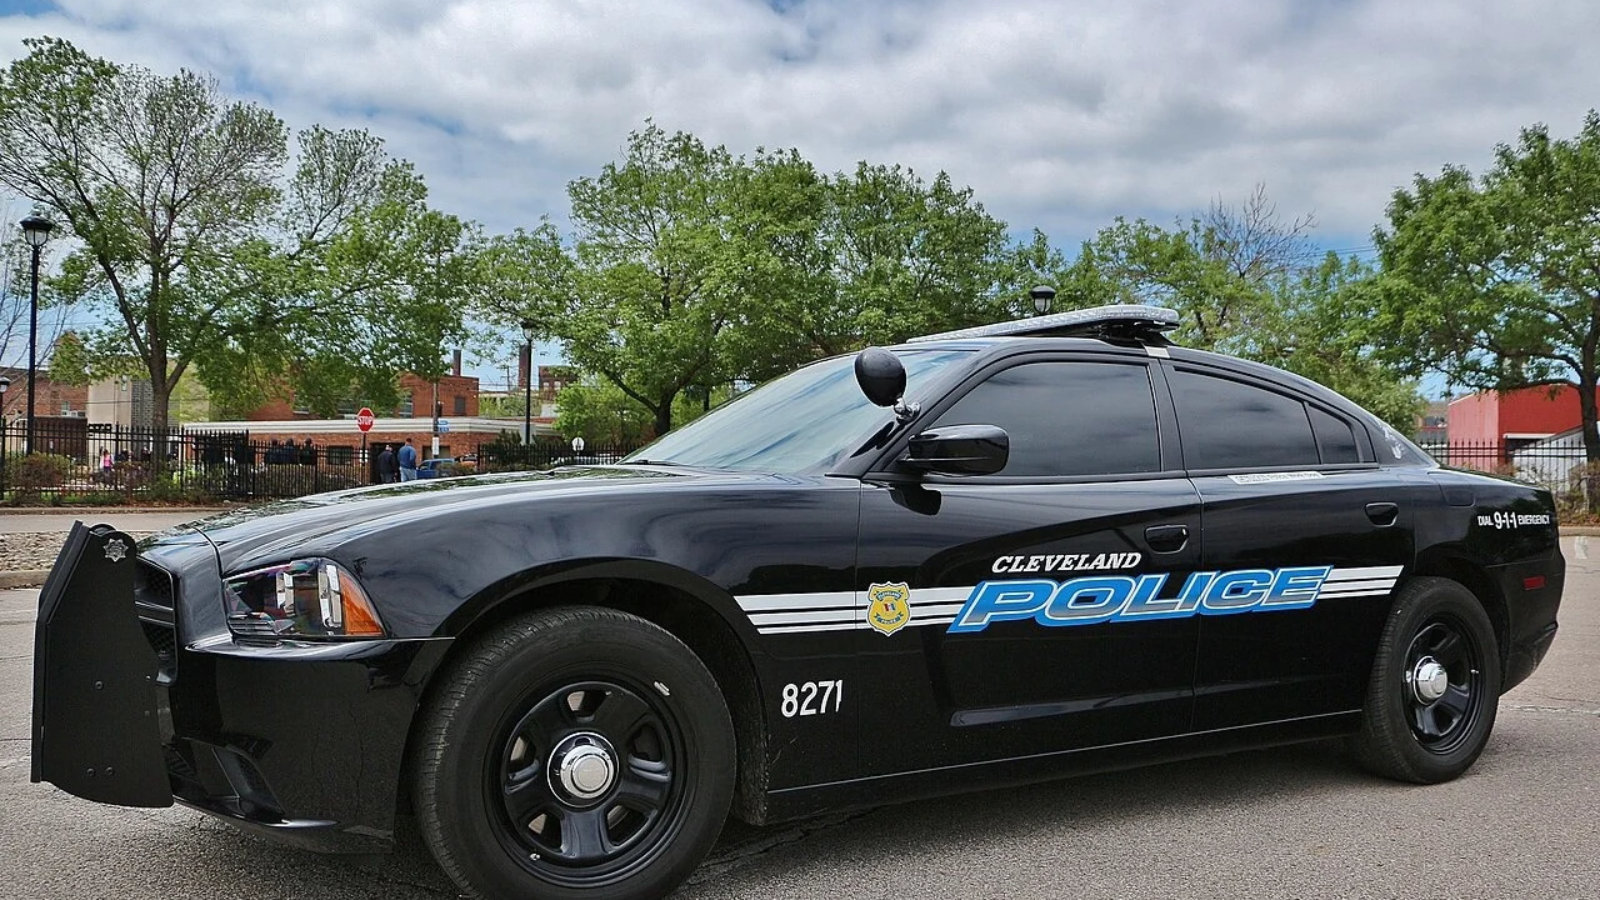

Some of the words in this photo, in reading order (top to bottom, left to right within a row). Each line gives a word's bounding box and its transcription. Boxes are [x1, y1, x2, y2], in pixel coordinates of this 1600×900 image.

[358, 415, 374, 425] STOP
[1477, 515, 1494, 526] DIAL
[1494, 511, 1518, 529] 9-1-1
[991, 552, 1142, 573] CLEVELAND
[947, 565, 1334, 633] POLICE
[781, 680, 843, 718] 8271
